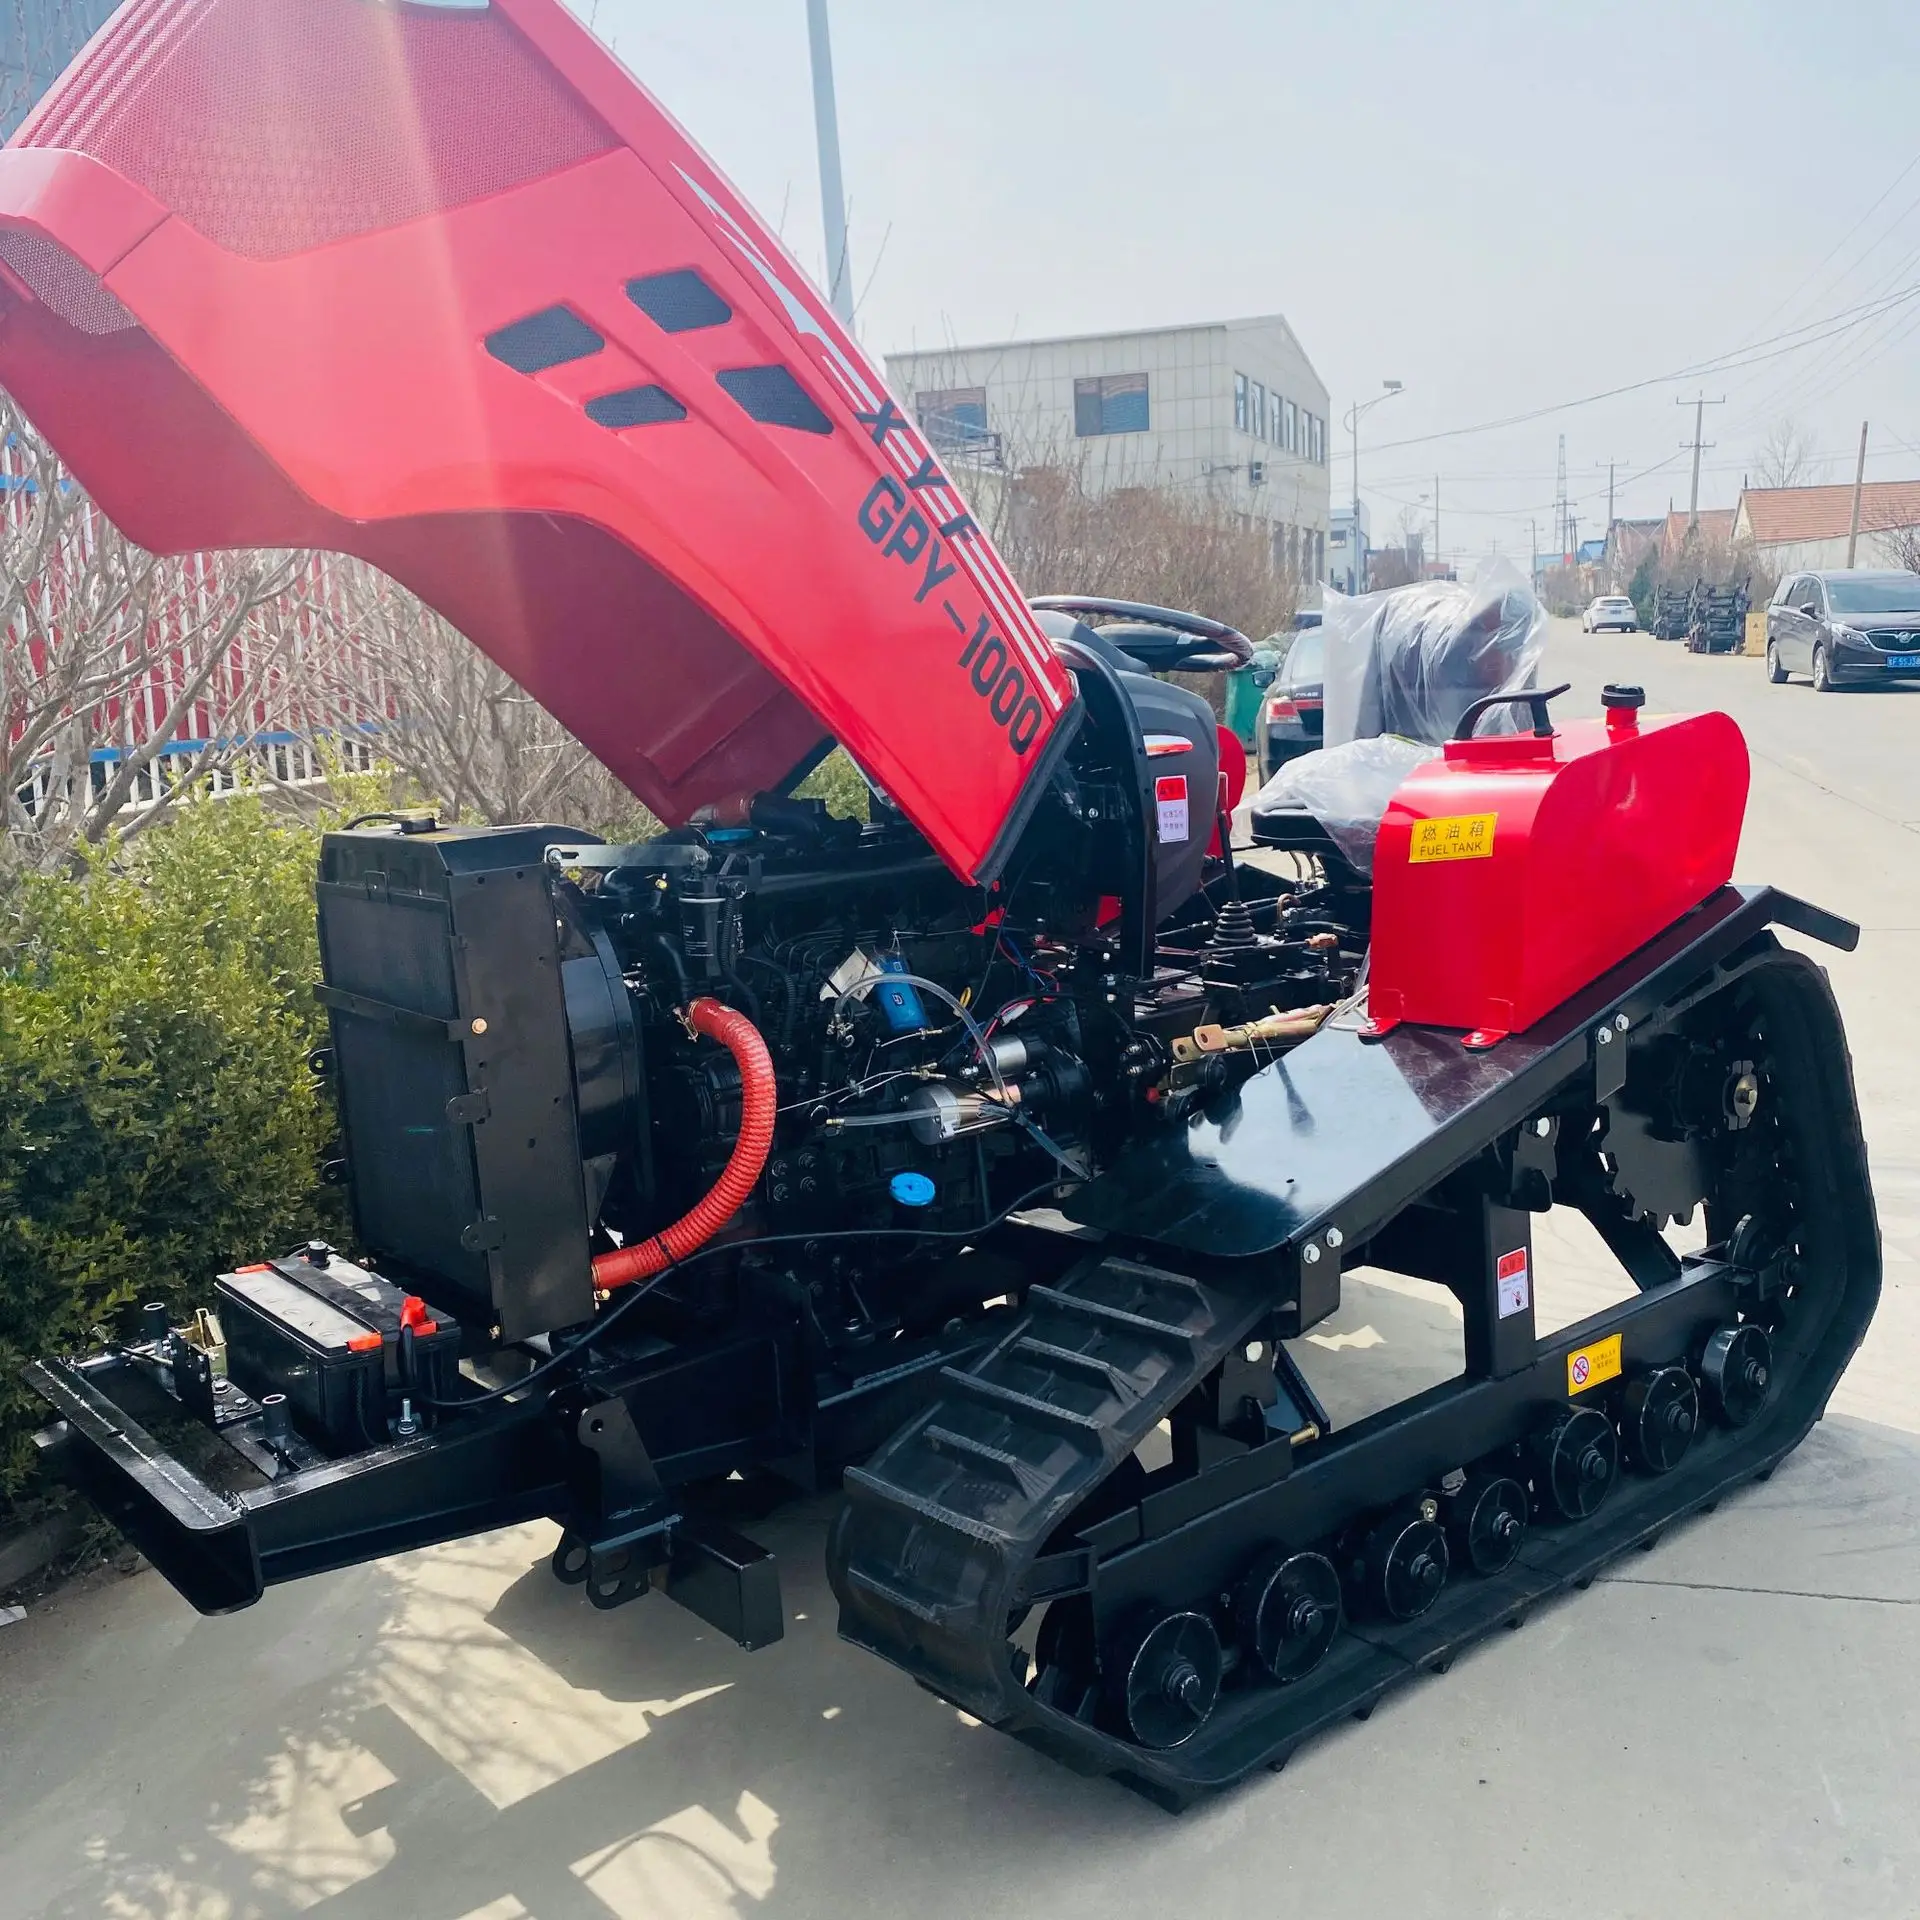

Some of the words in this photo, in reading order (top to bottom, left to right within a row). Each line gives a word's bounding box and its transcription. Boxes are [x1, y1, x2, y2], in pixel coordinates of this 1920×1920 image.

[857, 473, 1042, 756] GPY-1000
[1422, 820, 1486, 841] 燃油箱
[1420, 844, 1449, 856] FUEL
[1452, 841, 1482, 854] TANK
